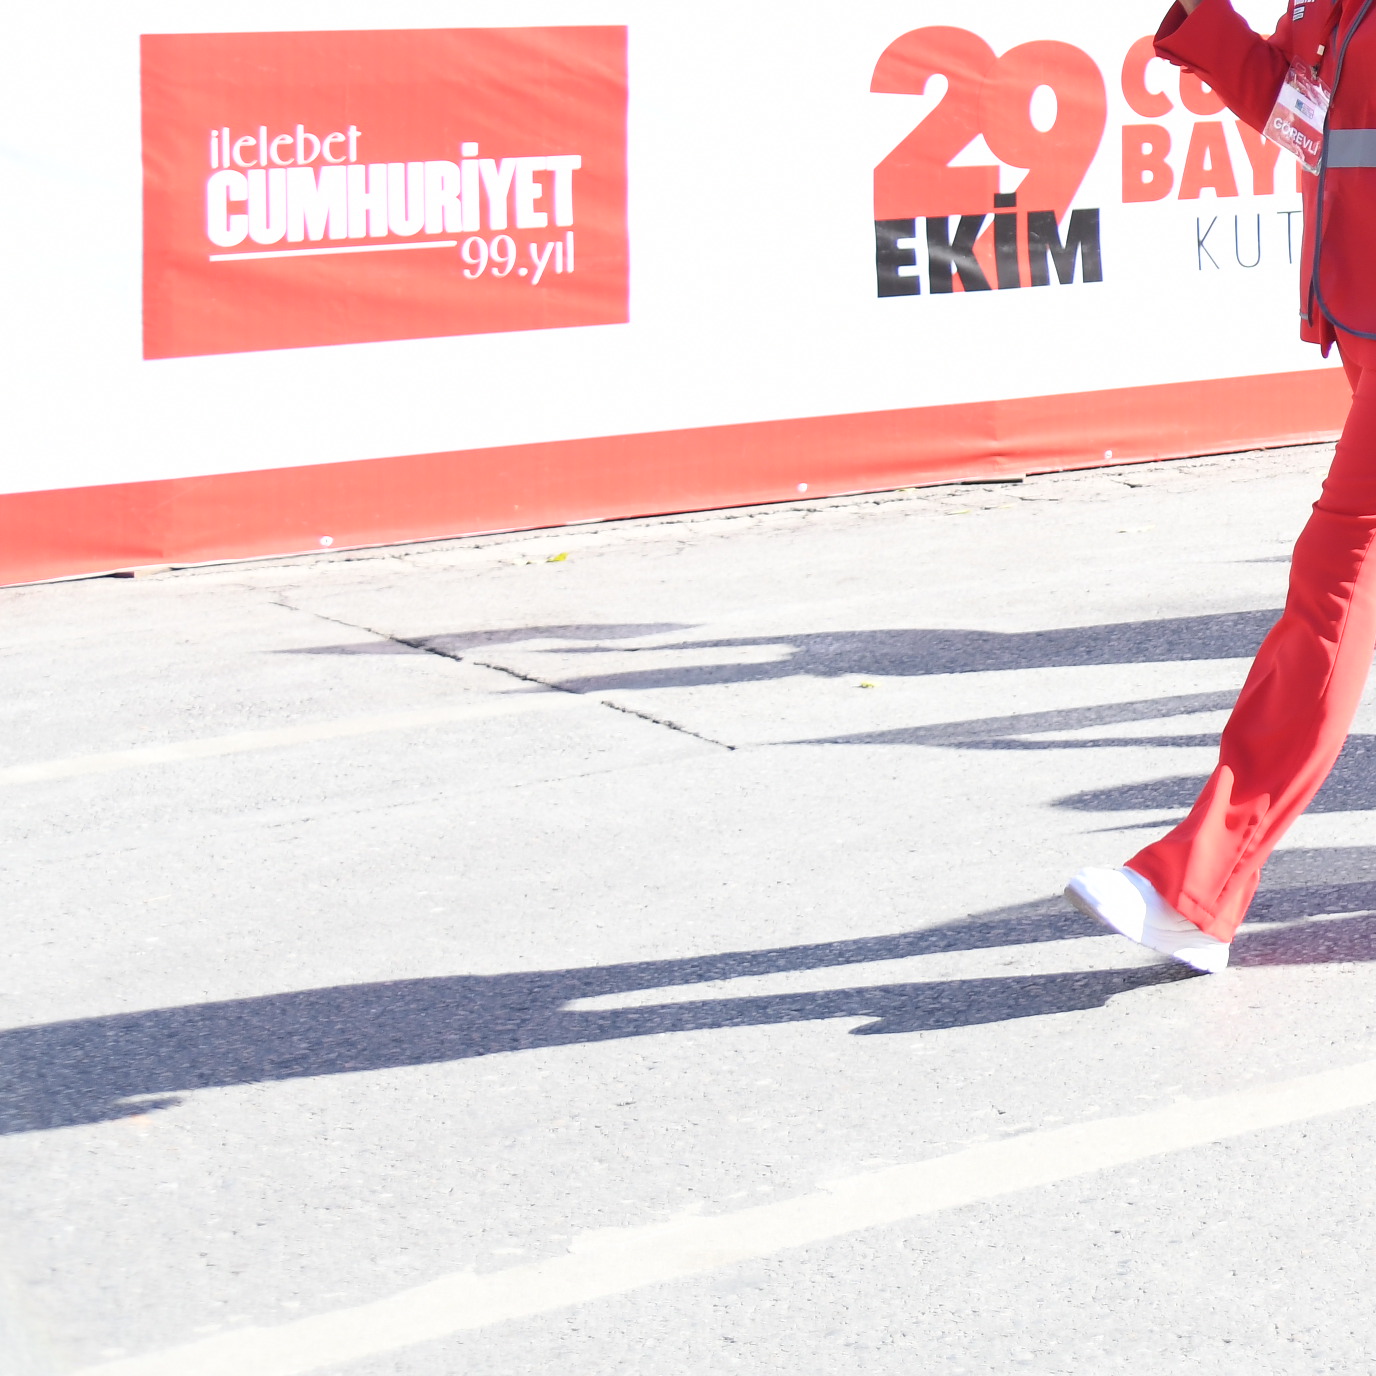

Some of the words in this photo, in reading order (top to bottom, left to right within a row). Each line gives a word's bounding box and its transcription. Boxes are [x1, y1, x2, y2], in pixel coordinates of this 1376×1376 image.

[210, 124, 361, 169] ilelebet
[870, 25, 1107, 224] 29
[1273, 117, 1321, 157] GÖREVLİ
[206, 142, 583, 248] CUMHURİYET
[460, 230, 575, 285] 99.yıl
[875, 192, 1103, 298] EKİM
